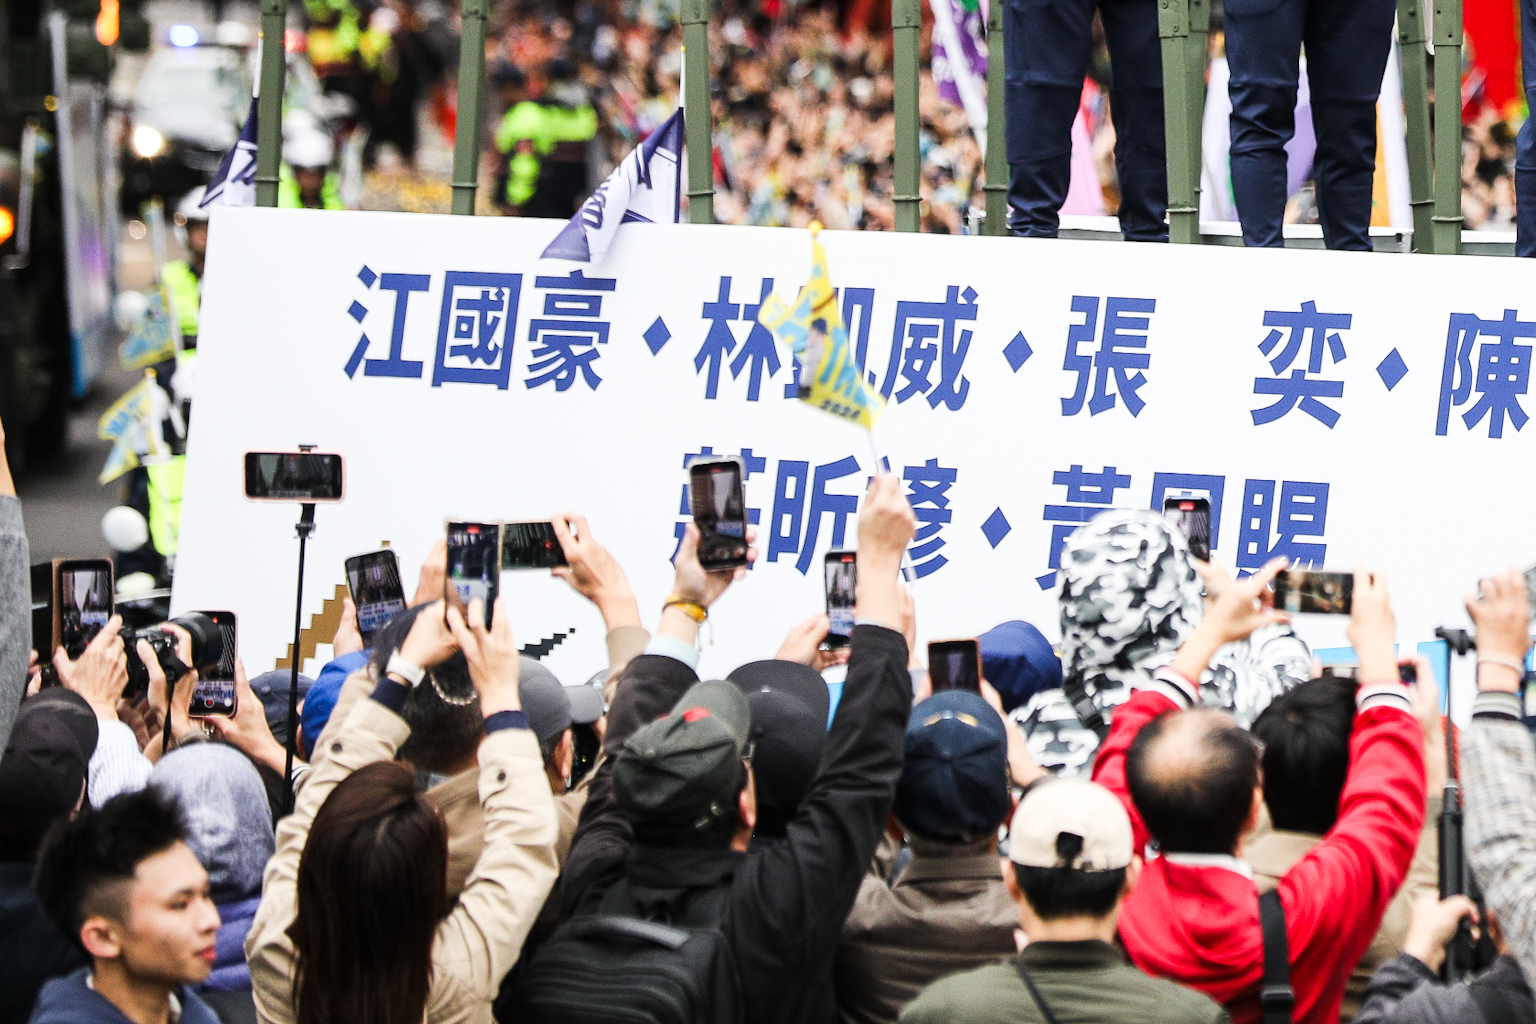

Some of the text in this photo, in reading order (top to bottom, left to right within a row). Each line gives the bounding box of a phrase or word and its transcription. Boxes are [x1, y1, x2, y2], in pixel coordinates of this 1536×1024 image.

[343, 264, 617, 392] 江國豪
[1060, 295, 1157, 418] 張
[1250, 300, 1353, 429] 奕
